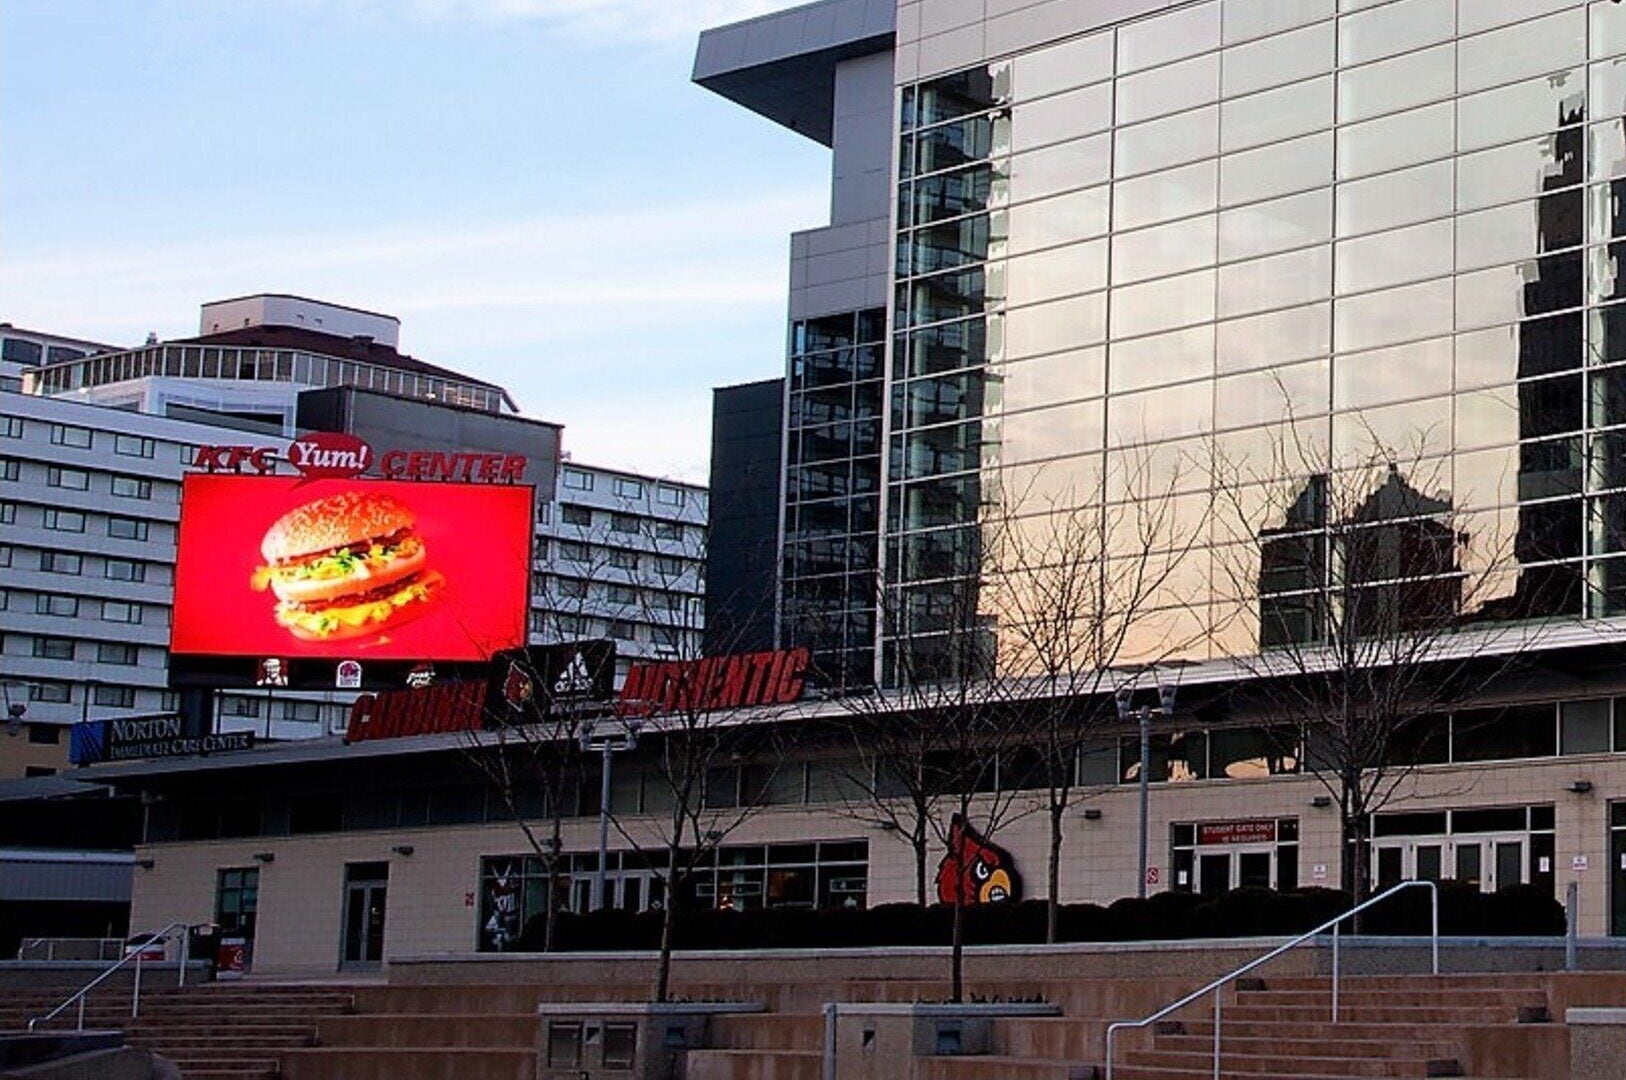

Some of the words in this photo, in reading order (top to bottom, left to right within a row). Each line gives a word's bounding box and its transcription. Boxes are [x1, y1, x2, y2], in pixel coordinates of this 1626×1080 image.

[193, 444, 279, 470] KFC
[295, 441, 367, 469] Yum!
[382, 449, 528, 479] CENTER
[554, 677, 593, 693] addas
[111, 717, 182, 743] NORTON
[203, 734, 249, 752] CENTER
